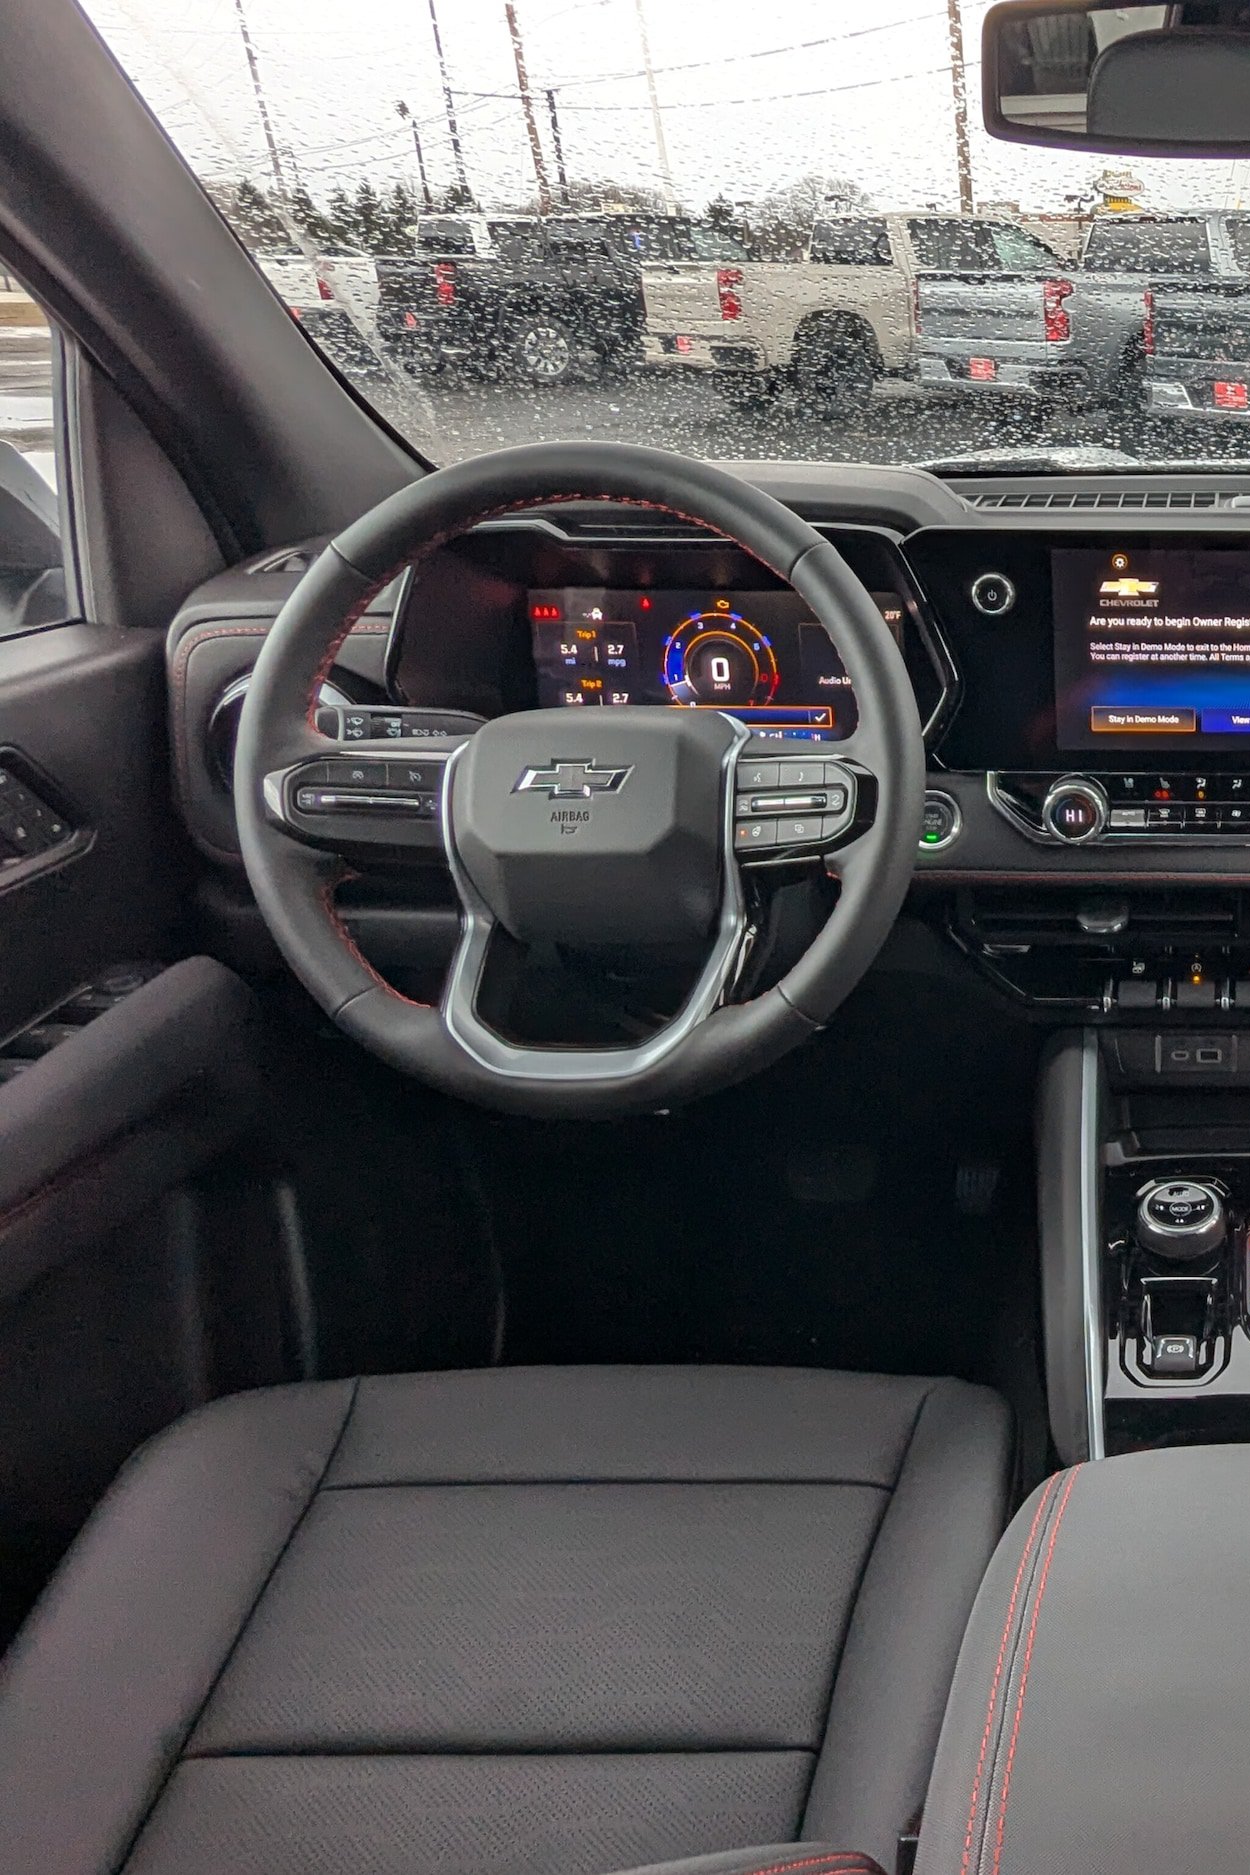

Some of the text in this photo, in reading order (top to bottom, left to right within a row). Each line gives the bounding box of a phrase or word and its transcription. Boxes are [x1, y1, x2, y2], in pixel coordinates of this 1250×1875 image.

[1100, 599, 1160, 608] CHEVROLET
[1089, 616, 1106, 626] Are
[1107, 618, 1126, 628] you
[1126, 616, 1152, 628] ready
[1154, 617, 1164, 626] to
[1165, 616, 1191, 628] begin
[1192, 617, 1223, 627] Owner
[577, 630, 592, 639] Trip
[560, 644, 625, 654] 5.4 2.7
[1090, 643, 1113, 652] Select
[1114, 643, 1131, 653] Stay
[1132, 643, 1140, 652] in
[1141, 643, 1163, 652] Demo
[1164, 643, 1185, 652] Mode
[1186, 643, 1194, 652] to
[1195, 643, 1212, 652] exit
[1213, 643, 1219, 652] to
[1220, 643, 1232, 652] the
[565, 657, 627, 667] mi mpg
[1090, 652, 1105, 661] You
[1106, 653, 1120, 661] can
[1121, 653, 1150, 662] register
[1151, 653, 1159, 661] at
[1160, 653, 1188, 662] another
[1189, 653, 1208, 662] time.
[1209, 653, 1219, 662] All
[1221, 653, 1244, 662] Terms
[711, 657, 730, 682] 0
[581, 680, 595, 689] Trip
[818, 676, 842, 685] Audio
[565, 693, 629, 704] 5.4 2.7
[1108, 715, 1180, 725] Stay in Demo Mode
[1231, 715, 1249, 725] View
[550, 810, 590, 823] AIRBAG
[1065, 809, 1083, 822] HI
